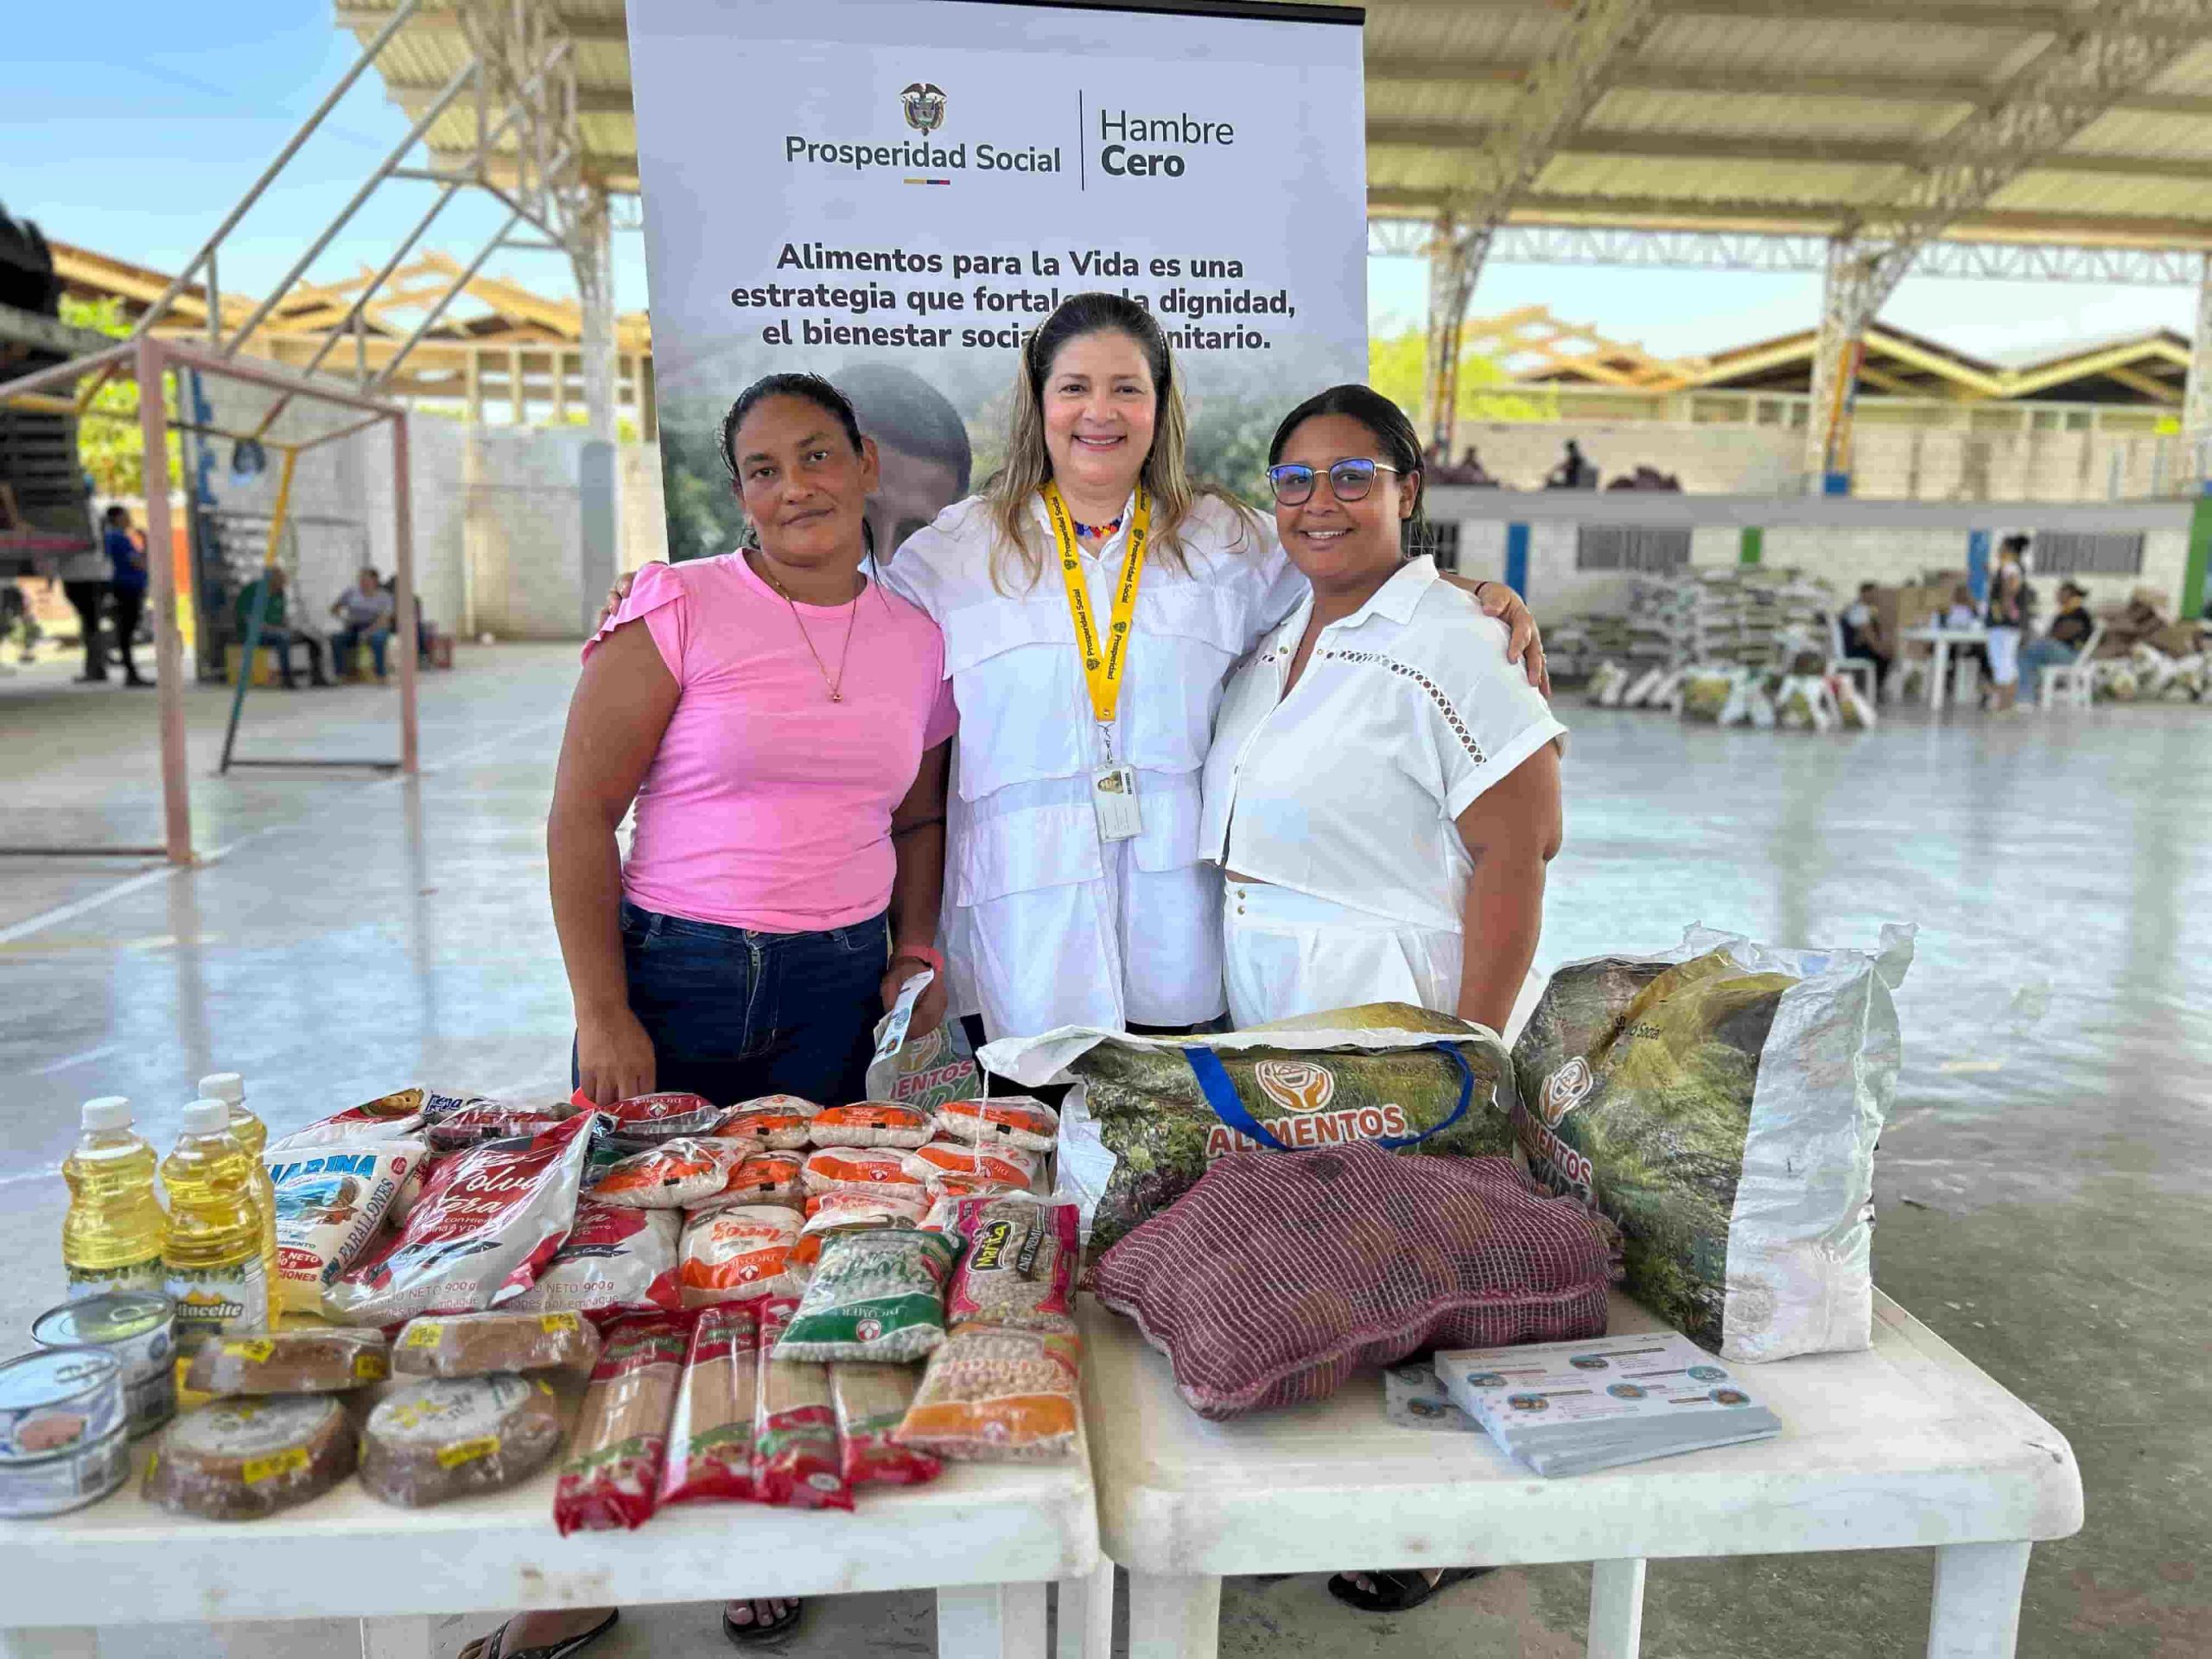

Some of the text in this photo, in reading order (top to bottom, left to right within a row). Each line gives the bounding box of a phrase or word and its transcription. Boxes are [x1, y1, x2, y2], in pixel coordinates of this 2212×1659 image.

[1101, 109, 1235, 145] Hambre
[785, 136, 1061, 173] Prosperidad Social
[1101, 145, 1185, 177] Cero
[777, 242, 1244, 279] Alimentos para la Vida es una
[731, 282, 897, 314] estrategia
[906, 290, 964, 315] que
[973, 286, 1074, 312] fortal
[1160, 288, 1295, 319] dignidad,
[762, 318, 1271, 350] el bienestar soci nitario.
[1057, 517, 1072, 557] Prosperidad
[1122, 540, 1141, 603] Prosperidad Social
[1072, 588, 1094, 657] Prosperidad Social
[1107, 634, 1122, 680] Prosperidad
[891, 1059, 974, 1099] ENTOS
[1210, 1105, 1406, 1153] ALMENTOS
[288, 1251, 319, 1263] NETO
[975, 1224, 1007, 1268] Marita
[278, 1269, 318, 1282] CIONES
[408, 1285, 443, 1298] NETO
[546, 1283, 579, 1294] NETO
